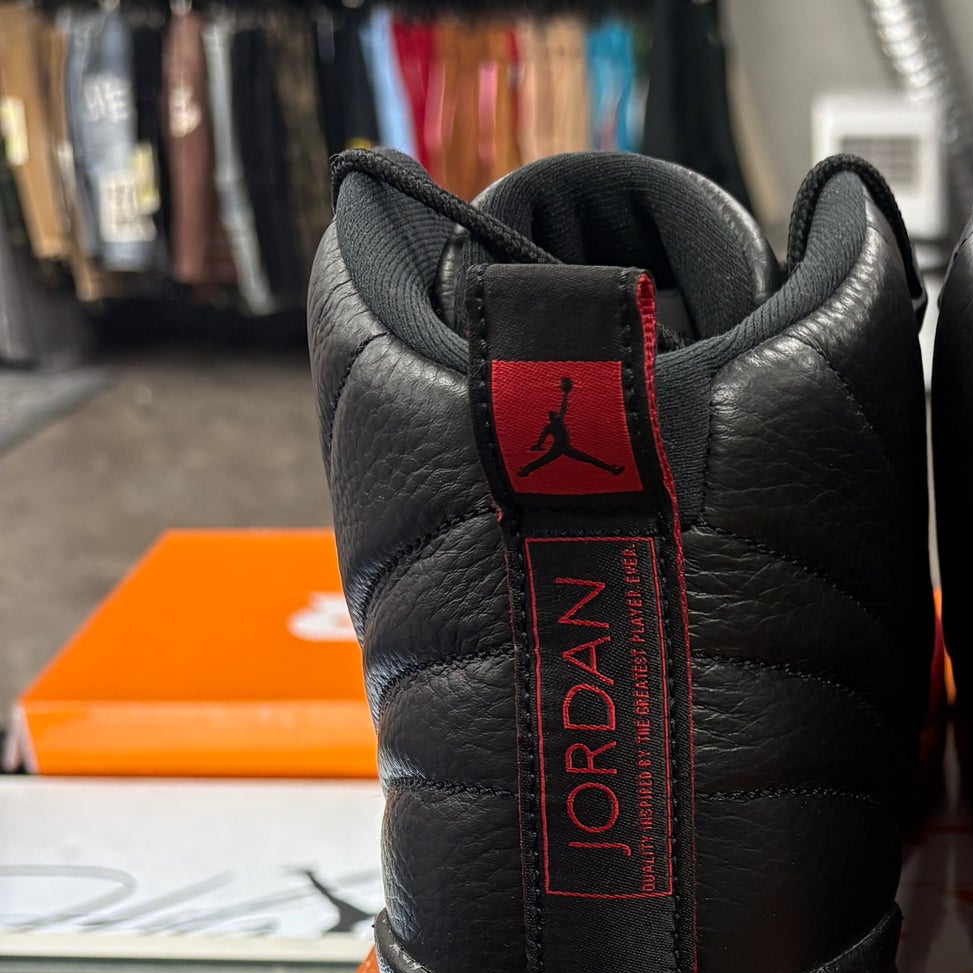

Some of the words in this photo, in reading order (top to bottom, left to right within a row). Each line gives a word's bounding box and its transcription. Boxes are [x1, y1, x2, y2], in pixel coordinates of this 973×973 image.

[626, 590, 646, 643] PLAYER
[632, 649, 650, 716] GREATEST
[555, 578, 632, 857] JORDAN
[636, 719, 651, 743] THE
[638, 751, 651, 767] BY
[640, 835, 656, 892] QUALITY
